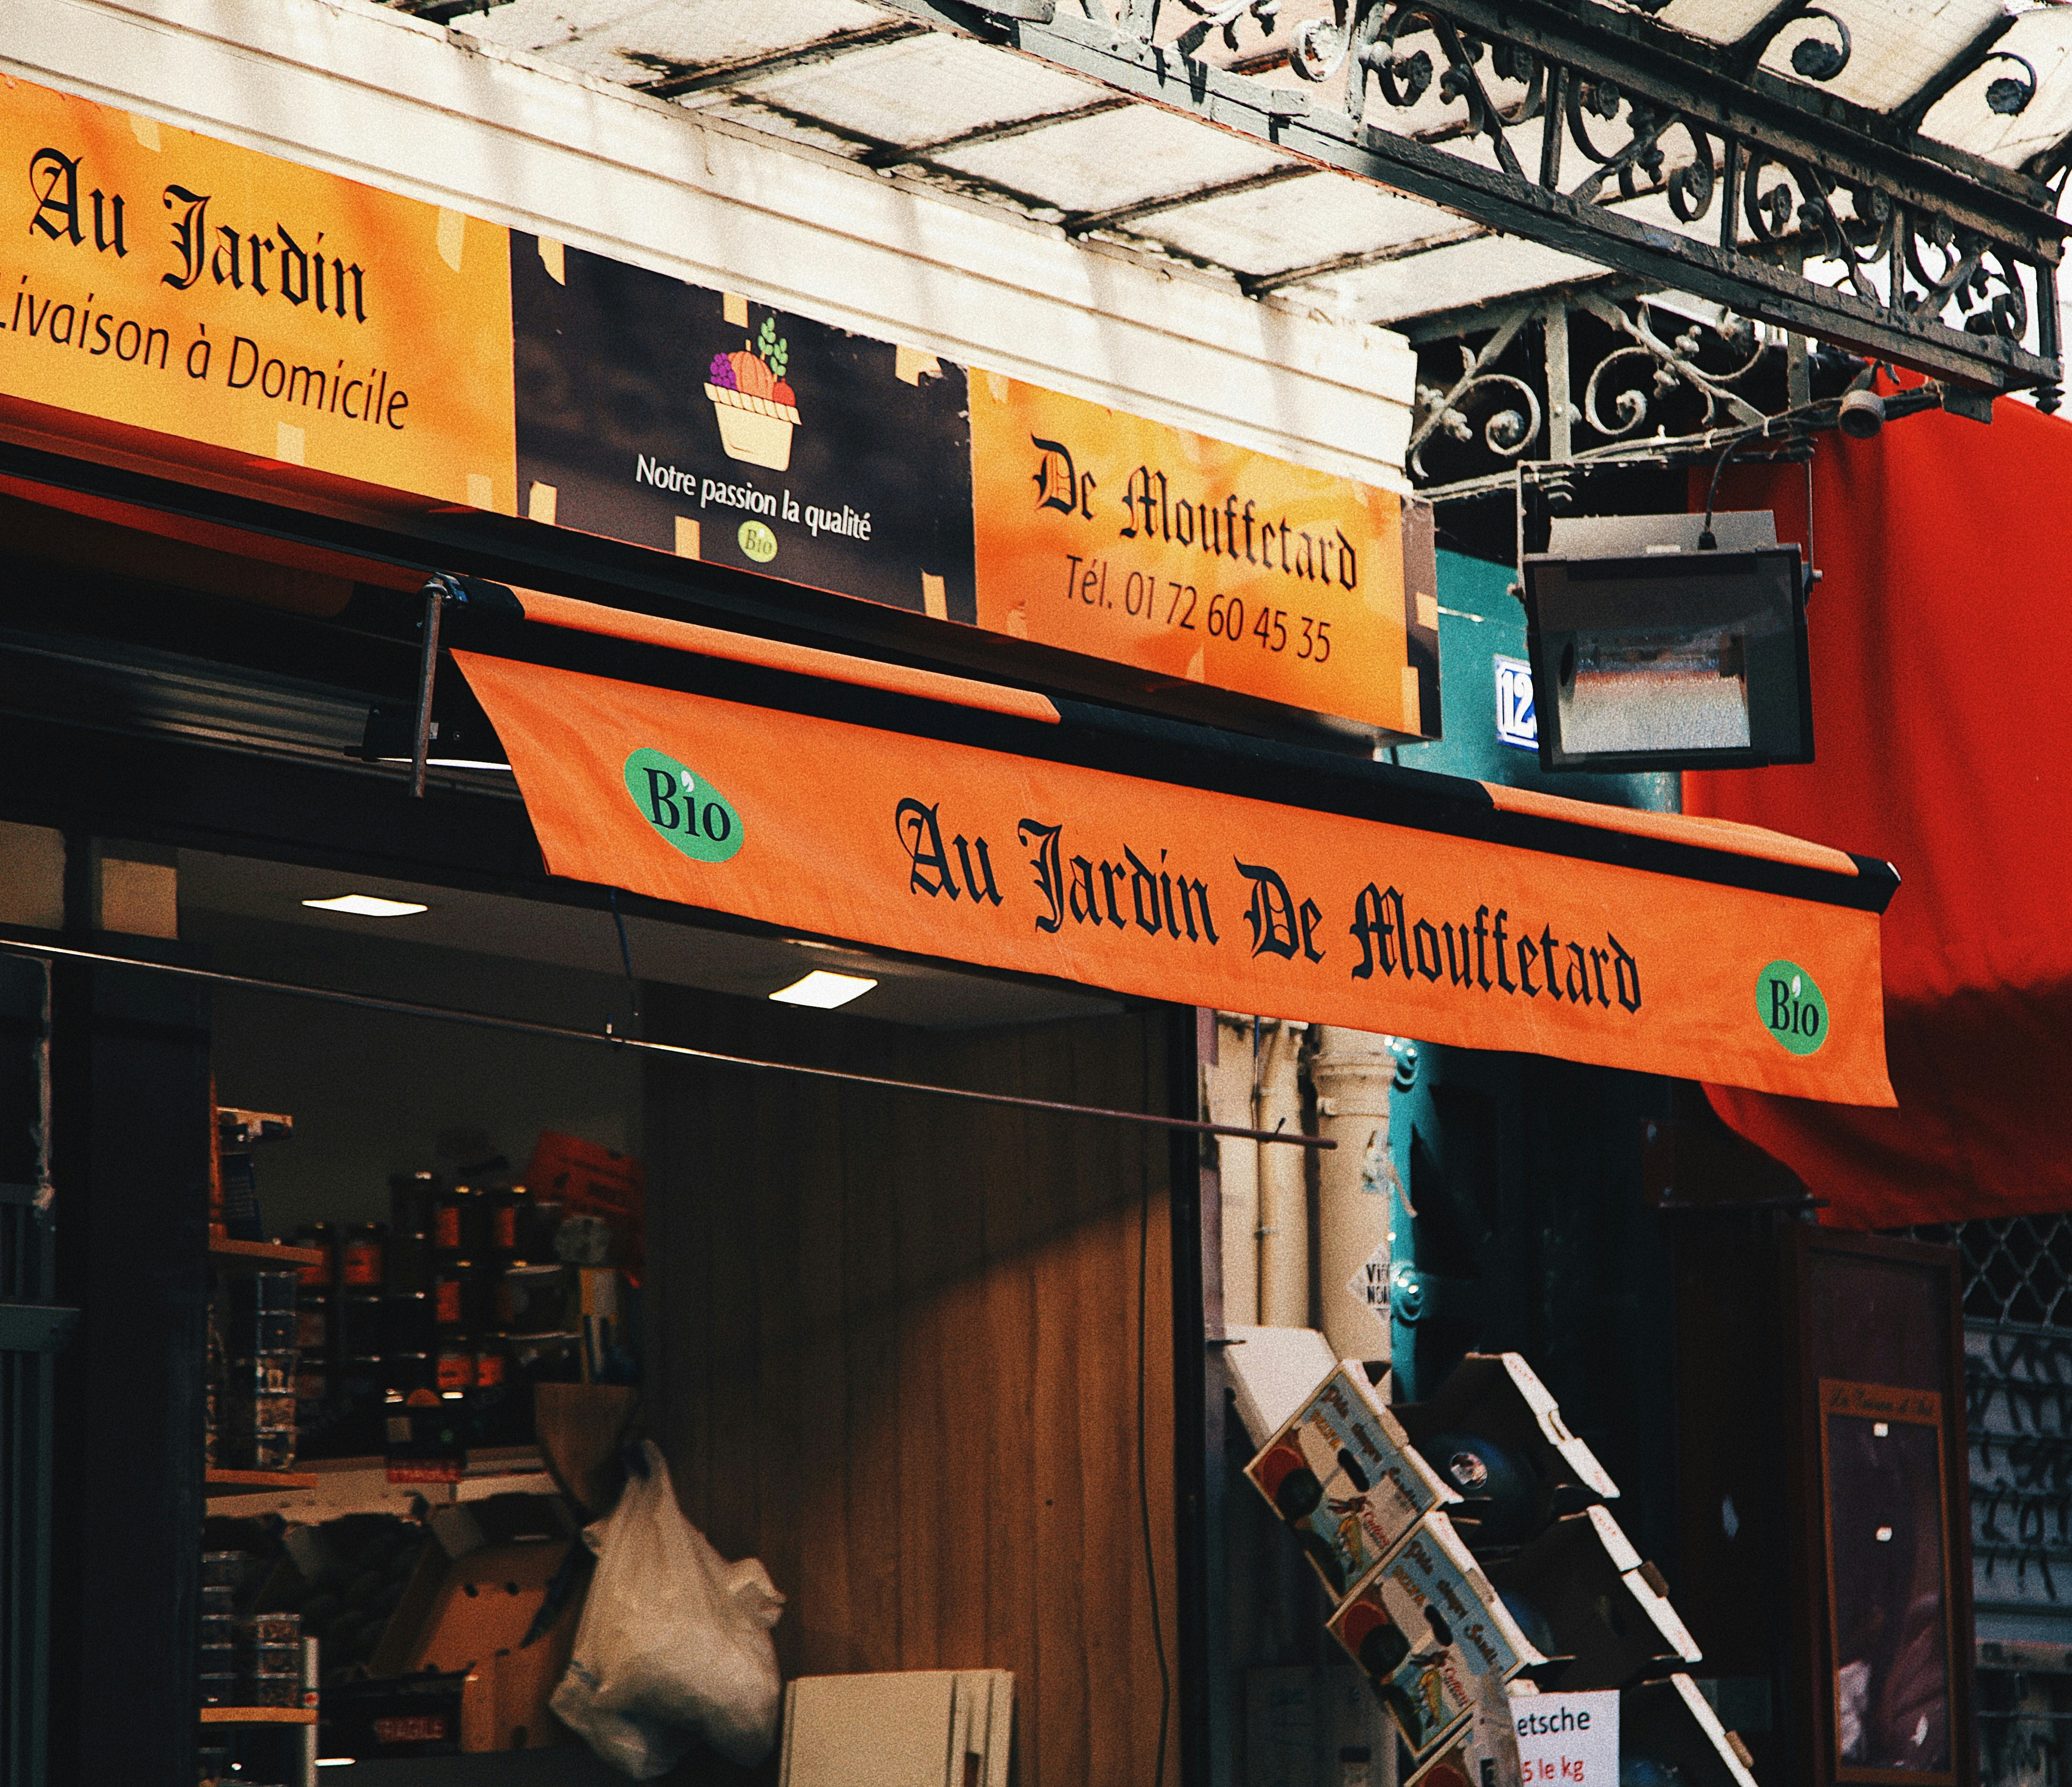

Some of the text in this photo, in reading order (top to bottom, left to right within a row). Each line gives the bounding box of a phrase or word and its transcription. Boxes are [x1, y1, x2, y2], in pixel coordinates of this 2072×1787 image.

[29, 147, 368, 324] Au Jardin
[0, 275, 409, 430] ivaison à Domicile
[636, 453, 872, 541] Notre passion la qualité
[1031, 432, 1357, 592] De Mouffetard
[745, 529, 772, 555] Bio
[1067, 554, 1331, 662] Tél. 01 72 60 45 35
[1502, 671, 1534, 739] 12
[642, 767, 731, 842] Bio
[895, 797, 1641, 1014] Au Jardin De Mouffetard
[1768, 975, 1820, 1038] Bio
[1518, 1706, 1590, 1736] etsche
[1539, 1758, 1555, 1779] le
[1562, 1755, 1585, 1783] kg
